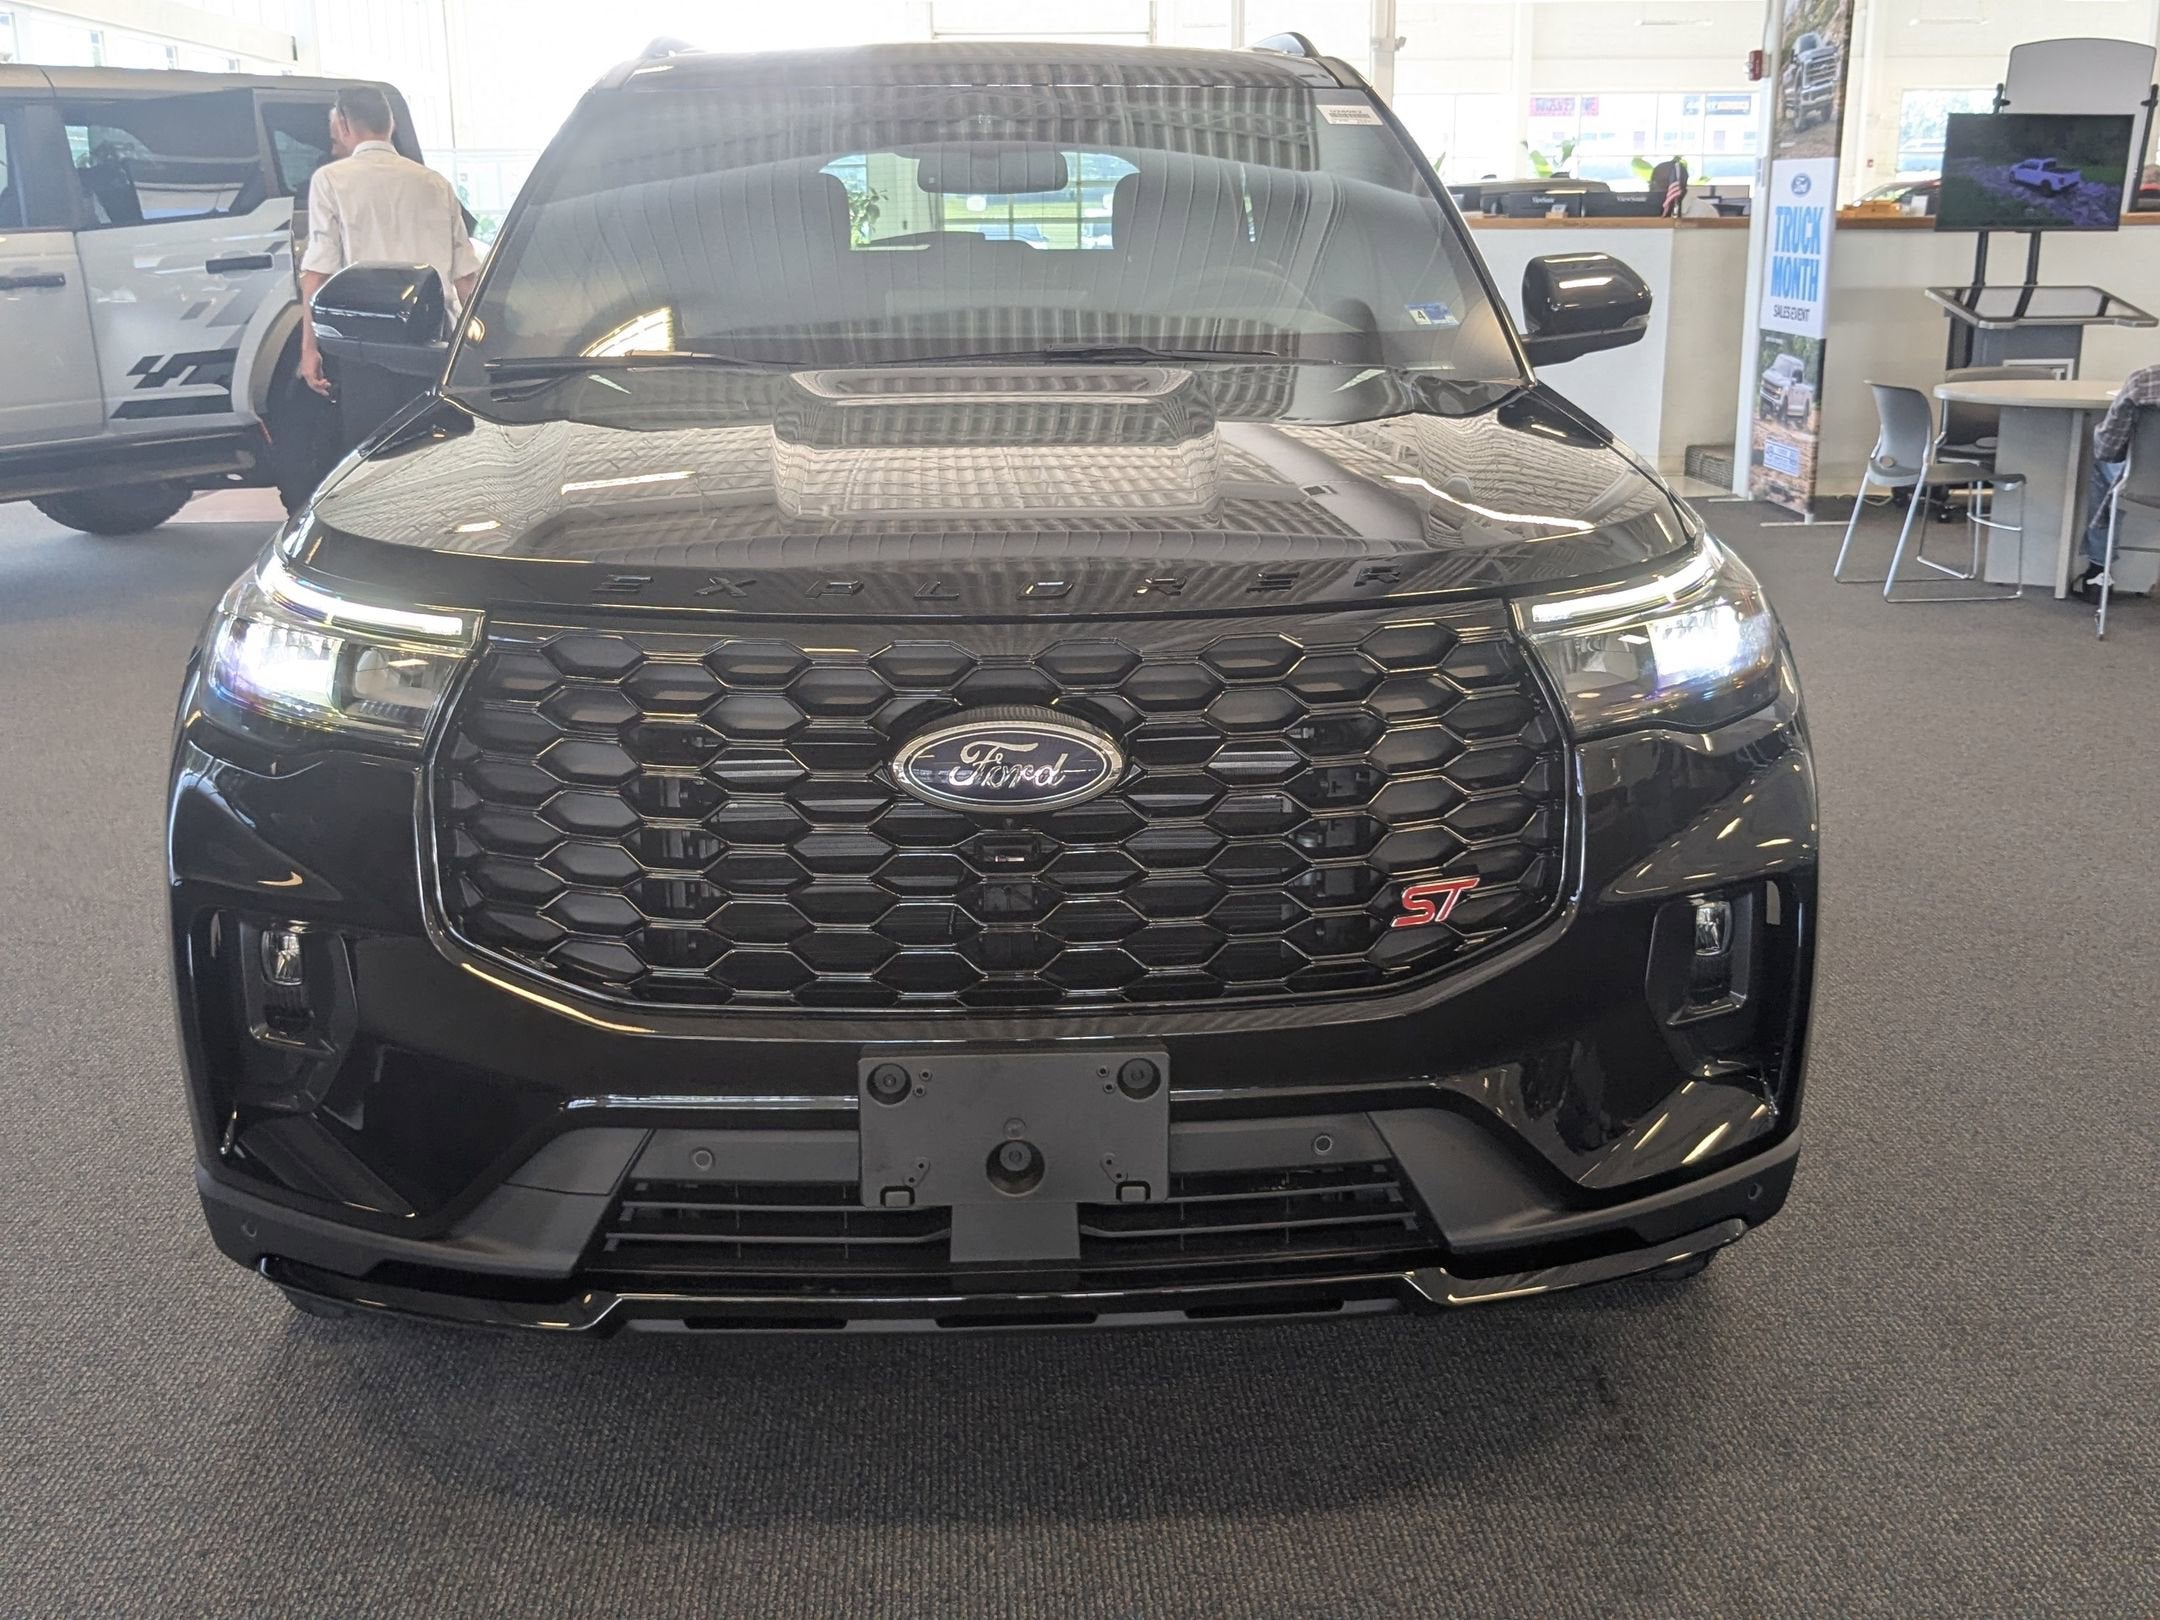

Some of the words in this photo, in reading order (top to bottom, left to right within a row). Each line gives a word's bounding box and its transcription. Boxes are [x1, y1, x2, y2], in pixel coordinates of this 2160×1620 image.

[1775, 206, 1824, 254] TRUCK
[1771, 256, 1819, 302] MONTH
[1773, 305, 1790, 320] SALES
[1791, 307, 1810, 322] EVENT
[592, 565, 1400, 600] EXPLORER
[949, 740, 1068, 788] Ford
[1391, 878, 1480, 927] ST
